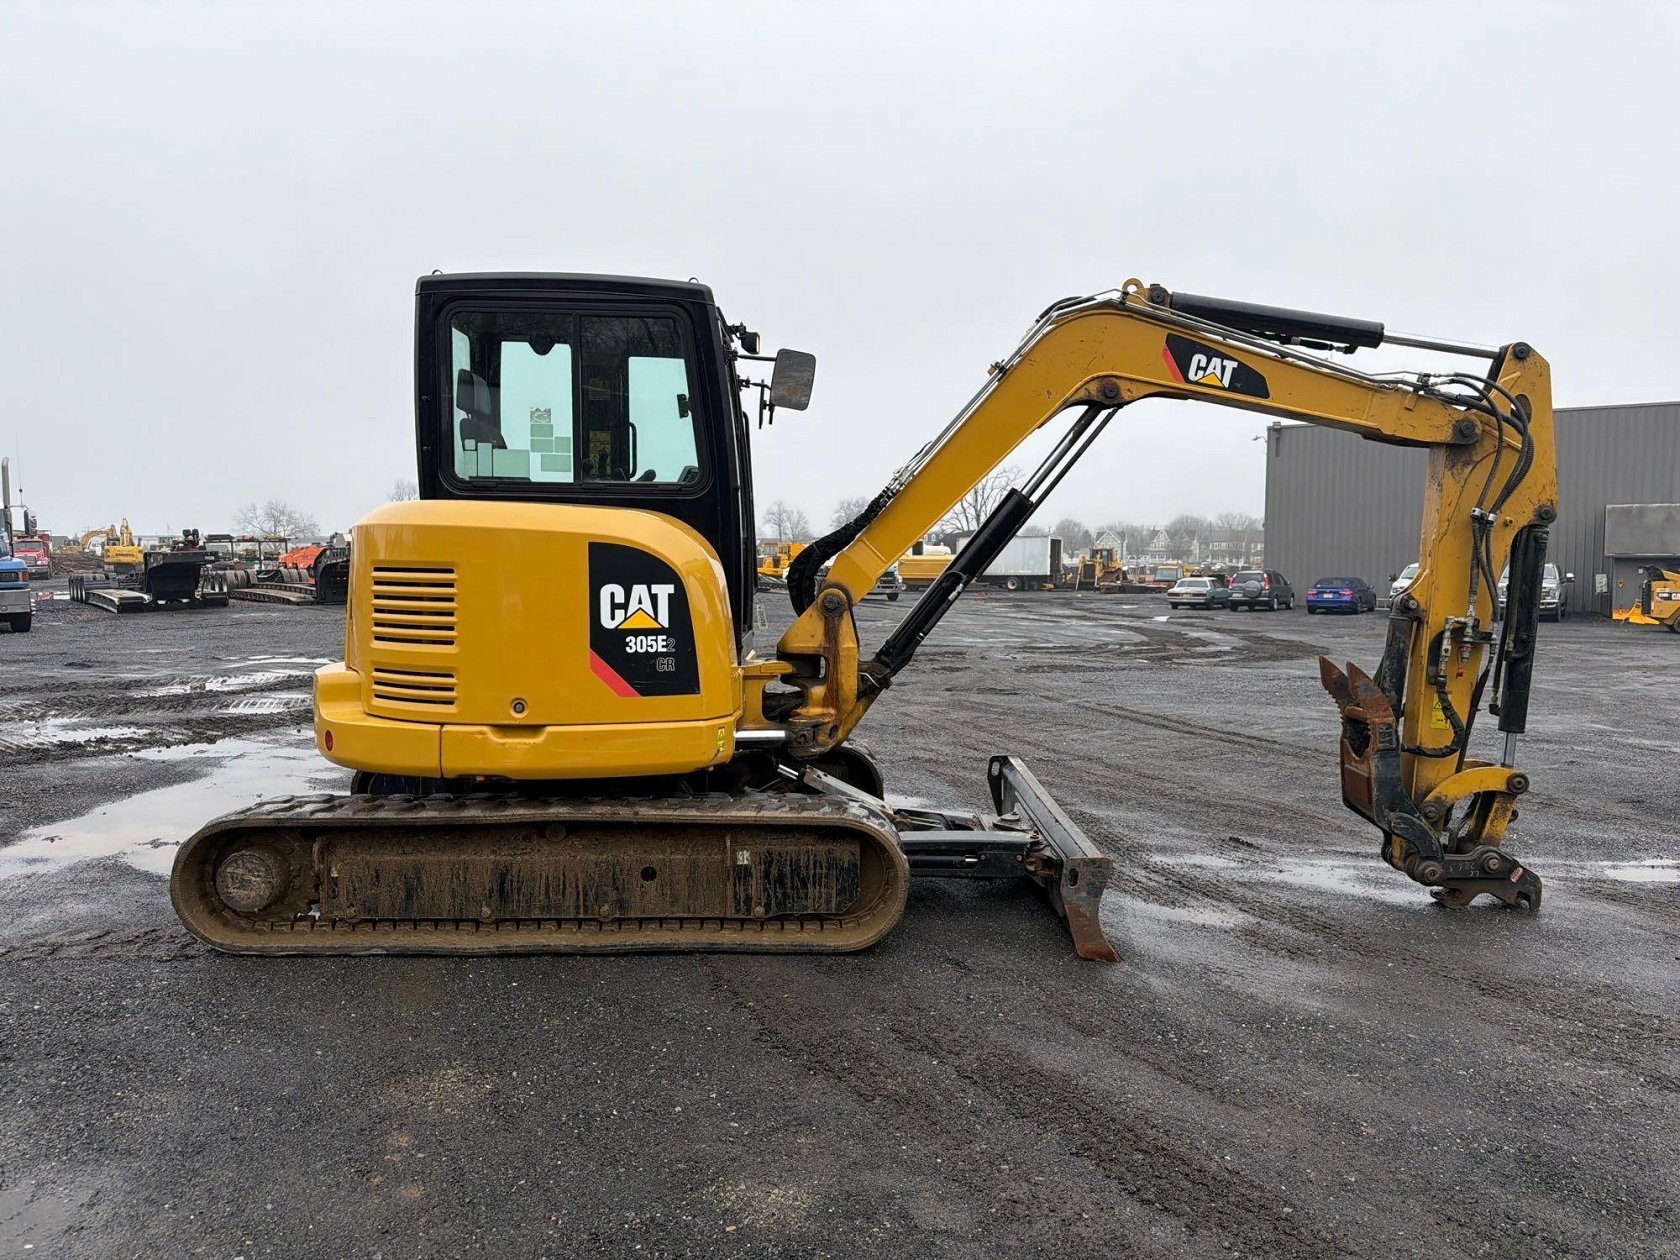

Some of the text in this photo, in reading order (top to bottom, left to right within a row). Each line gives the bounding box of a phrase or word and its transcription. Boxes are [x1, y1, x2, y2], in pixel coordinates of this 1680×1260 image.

[1188, 353, 1238, 388] CAT
[600, 583, 675, 629] CAT
[625, 635, 676, 653] 305E2
[656, 657, 676, 672] CR
